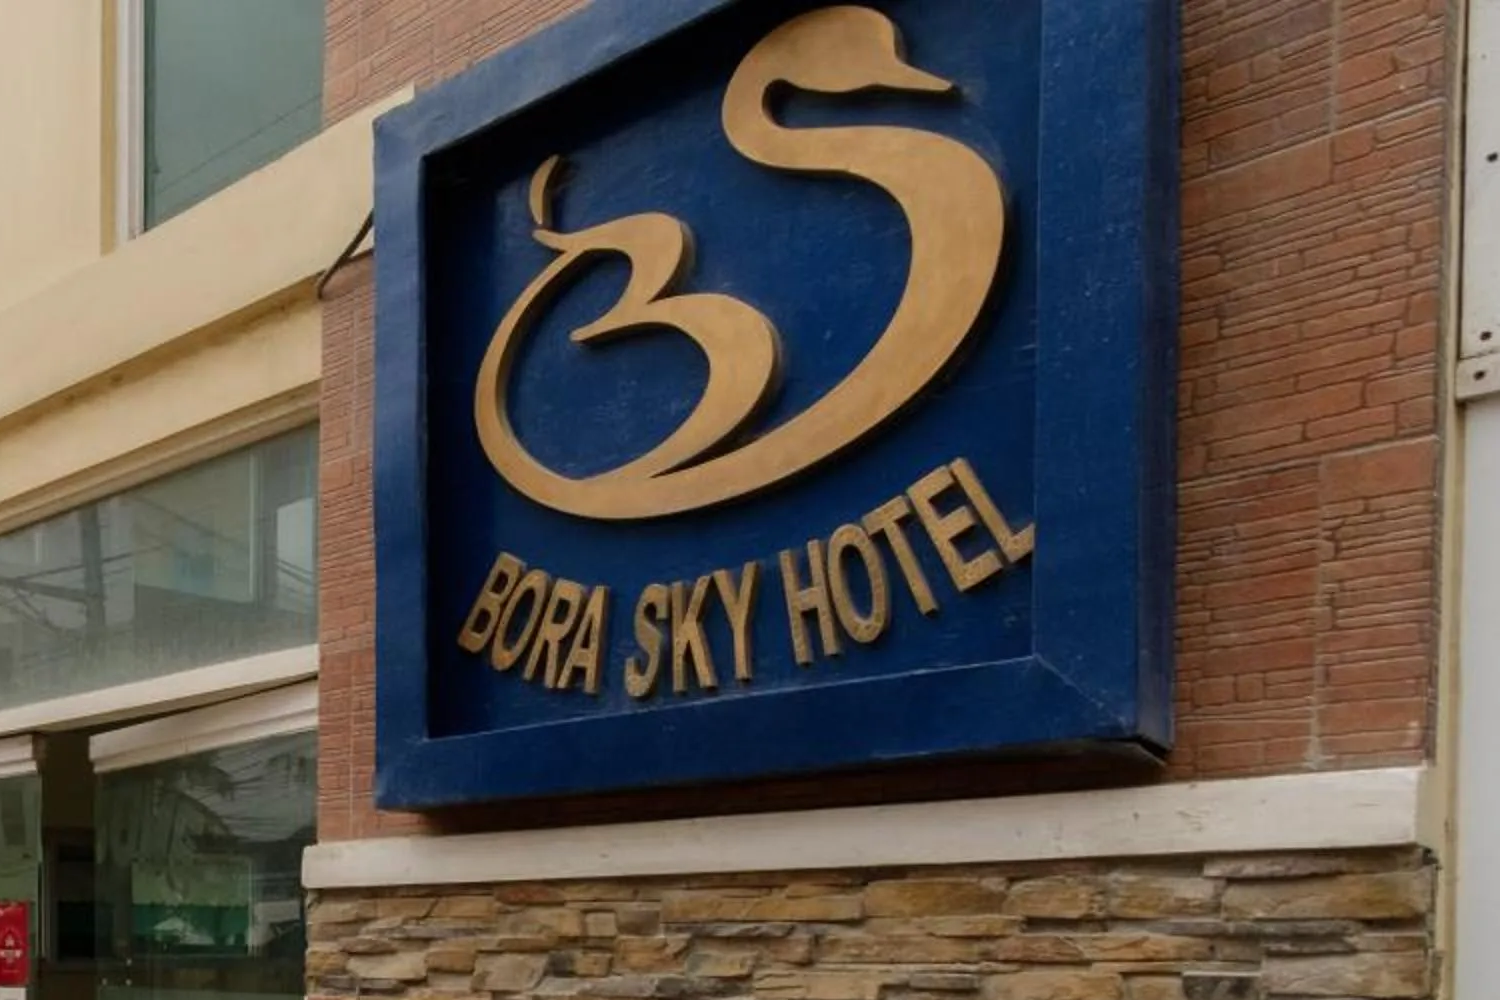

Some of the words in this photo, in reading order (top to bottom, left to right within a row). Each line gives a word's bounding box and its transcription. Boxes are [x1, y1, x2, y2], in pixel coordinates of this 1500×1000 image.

[457, 551, 609, 694] BORA
[625, 560, 761, 698] SKY
[778, 457, 1036, 666] HOTEL
